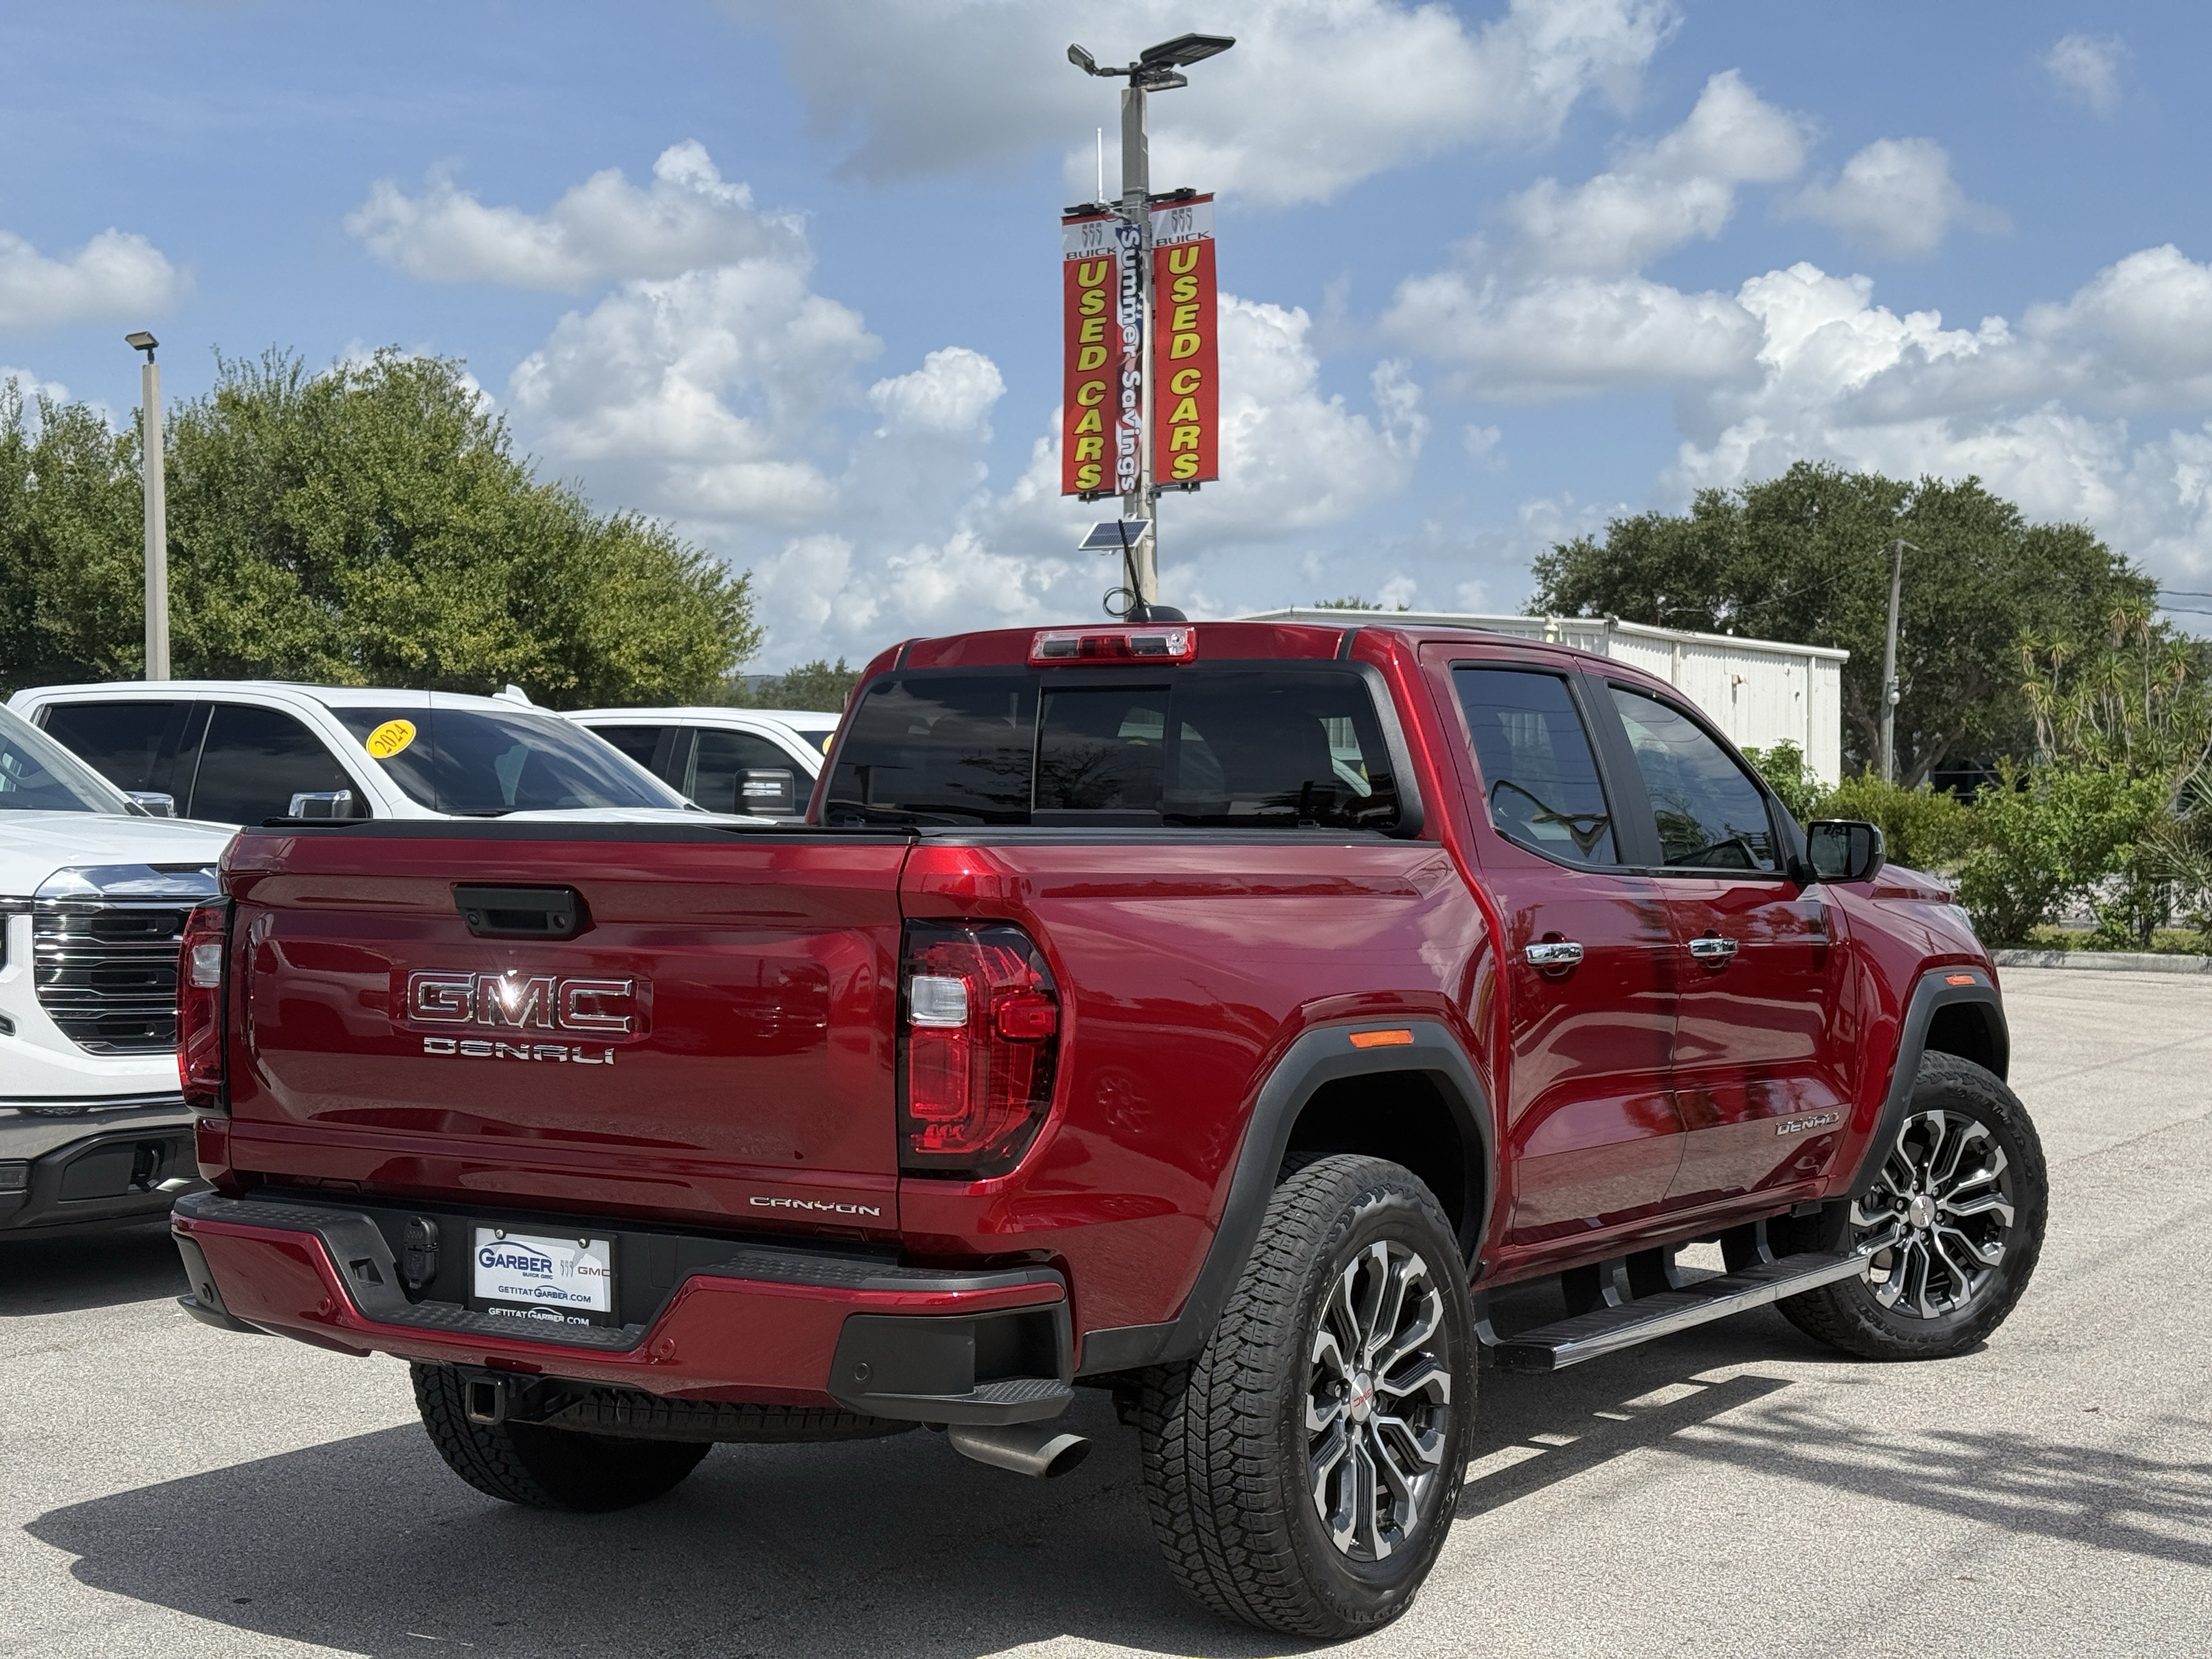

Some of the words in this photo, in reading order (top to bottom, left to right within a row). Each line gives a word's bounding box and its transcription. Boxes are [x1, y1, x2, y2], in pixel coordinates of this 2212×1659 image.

[1066, 246, 1116, 259] BUICK
[1156, 230, 1210, 246] BUICK
[1120, 230, 1142, 358] Summer
[1168, 244, 1202, 360] USED
[1076, 260, 1109, 371] USED
[1073, 380, 1107, 490] CARS
[1116, 371, 1141, 491] Savings
[1167, 368, 1202, 479] CARS
[374, 723, 408, 754] 2024
[407, 969, 633, 1033] GMC
[424, 1036, 615, 1065] DENALI
[1776, 1112, 1839, 1136] DENALI
[749, 1196, 881, 1217] CANYON
[478, 1248, 553, 1274] GARBER
[578, 1266, 611, 1277] GMC
[1353, 1388, 1373, 1408] GMC
